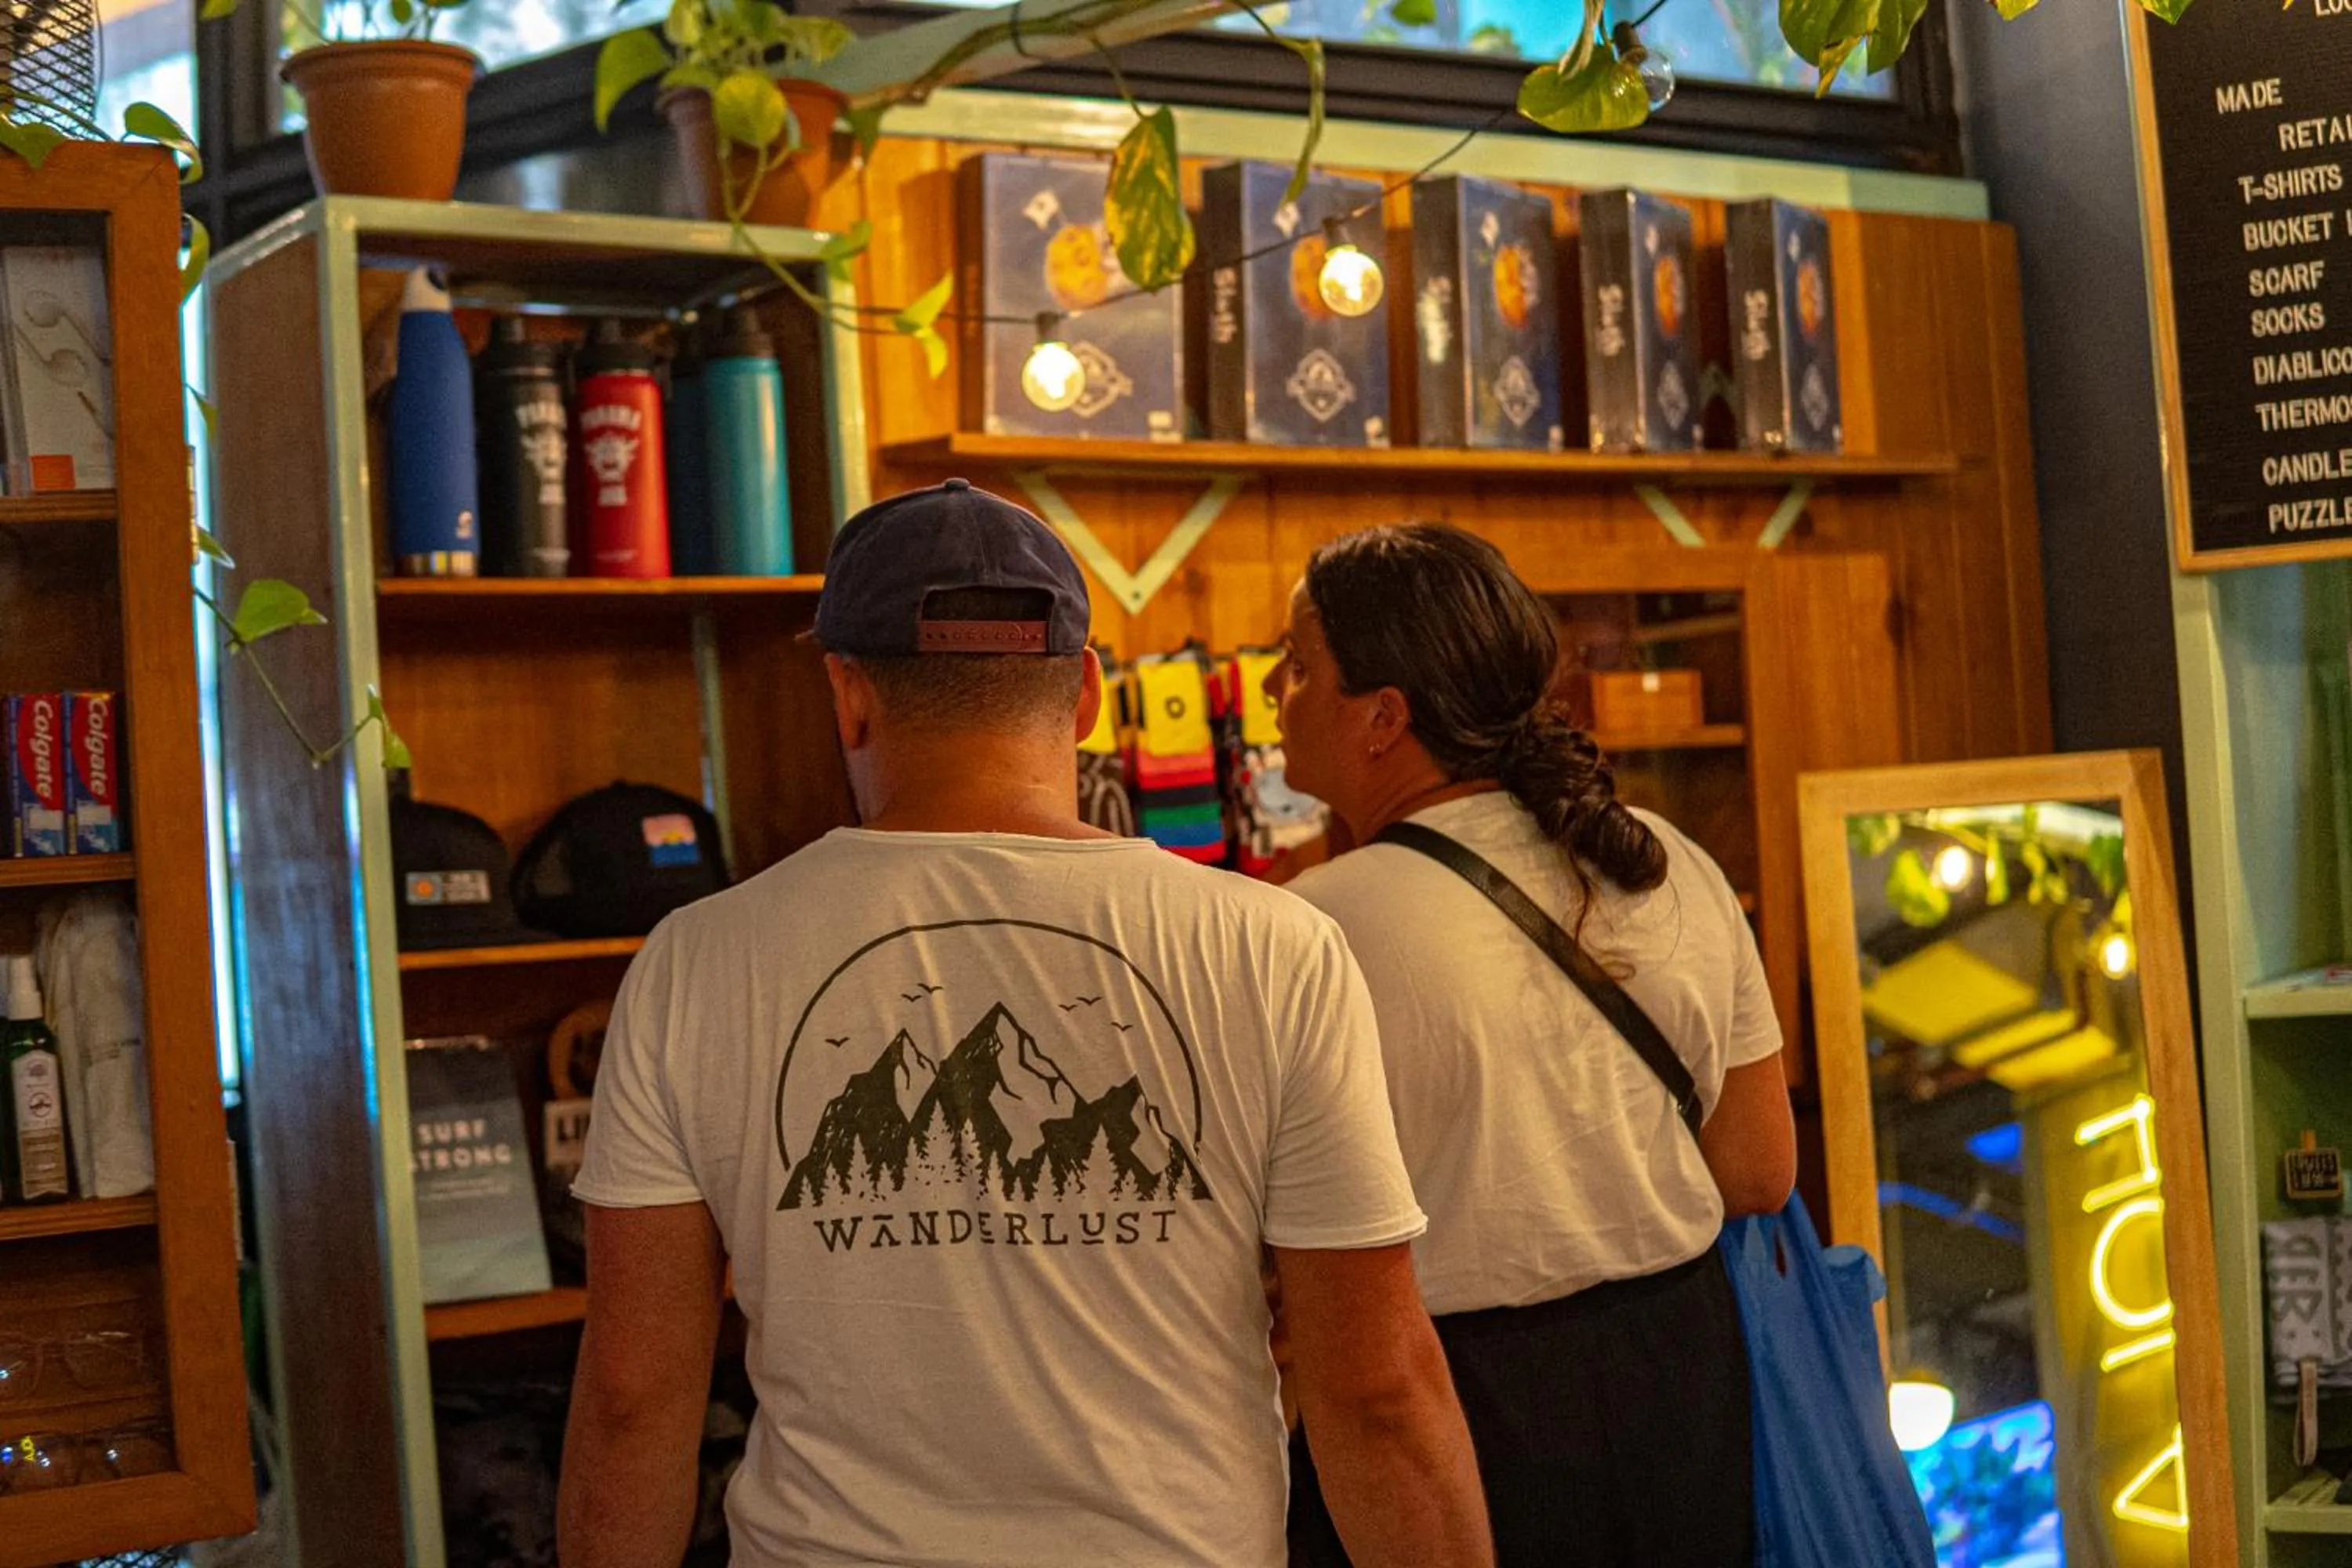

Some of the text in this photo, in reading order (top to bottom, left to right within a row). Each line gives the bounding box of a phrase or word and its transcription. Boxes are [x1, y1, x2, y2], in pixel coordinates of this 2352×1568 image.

[2216, 78, 2283, 114] MADE
[2238, 164, 2343, 205] T-SHIRTS
[2243, 212, 2333, 251] BUCKET
[2249, 260, 2325, 297] SCARF
[2251, 302, 2325, 338] SOCKS
[2253, 347, 2352, 385] DIABLICO
[2255, 395, 2352, 432] THERMO
[2262, 448, 2352, 486] CANDLE
[2268, 496, 2352, 534] PUZZLE
[30, 700, 53, 799] Colgate
[84, 699, 108, 796] Colgate
[814, 1210, 1176, 1253] WANDERLUST
